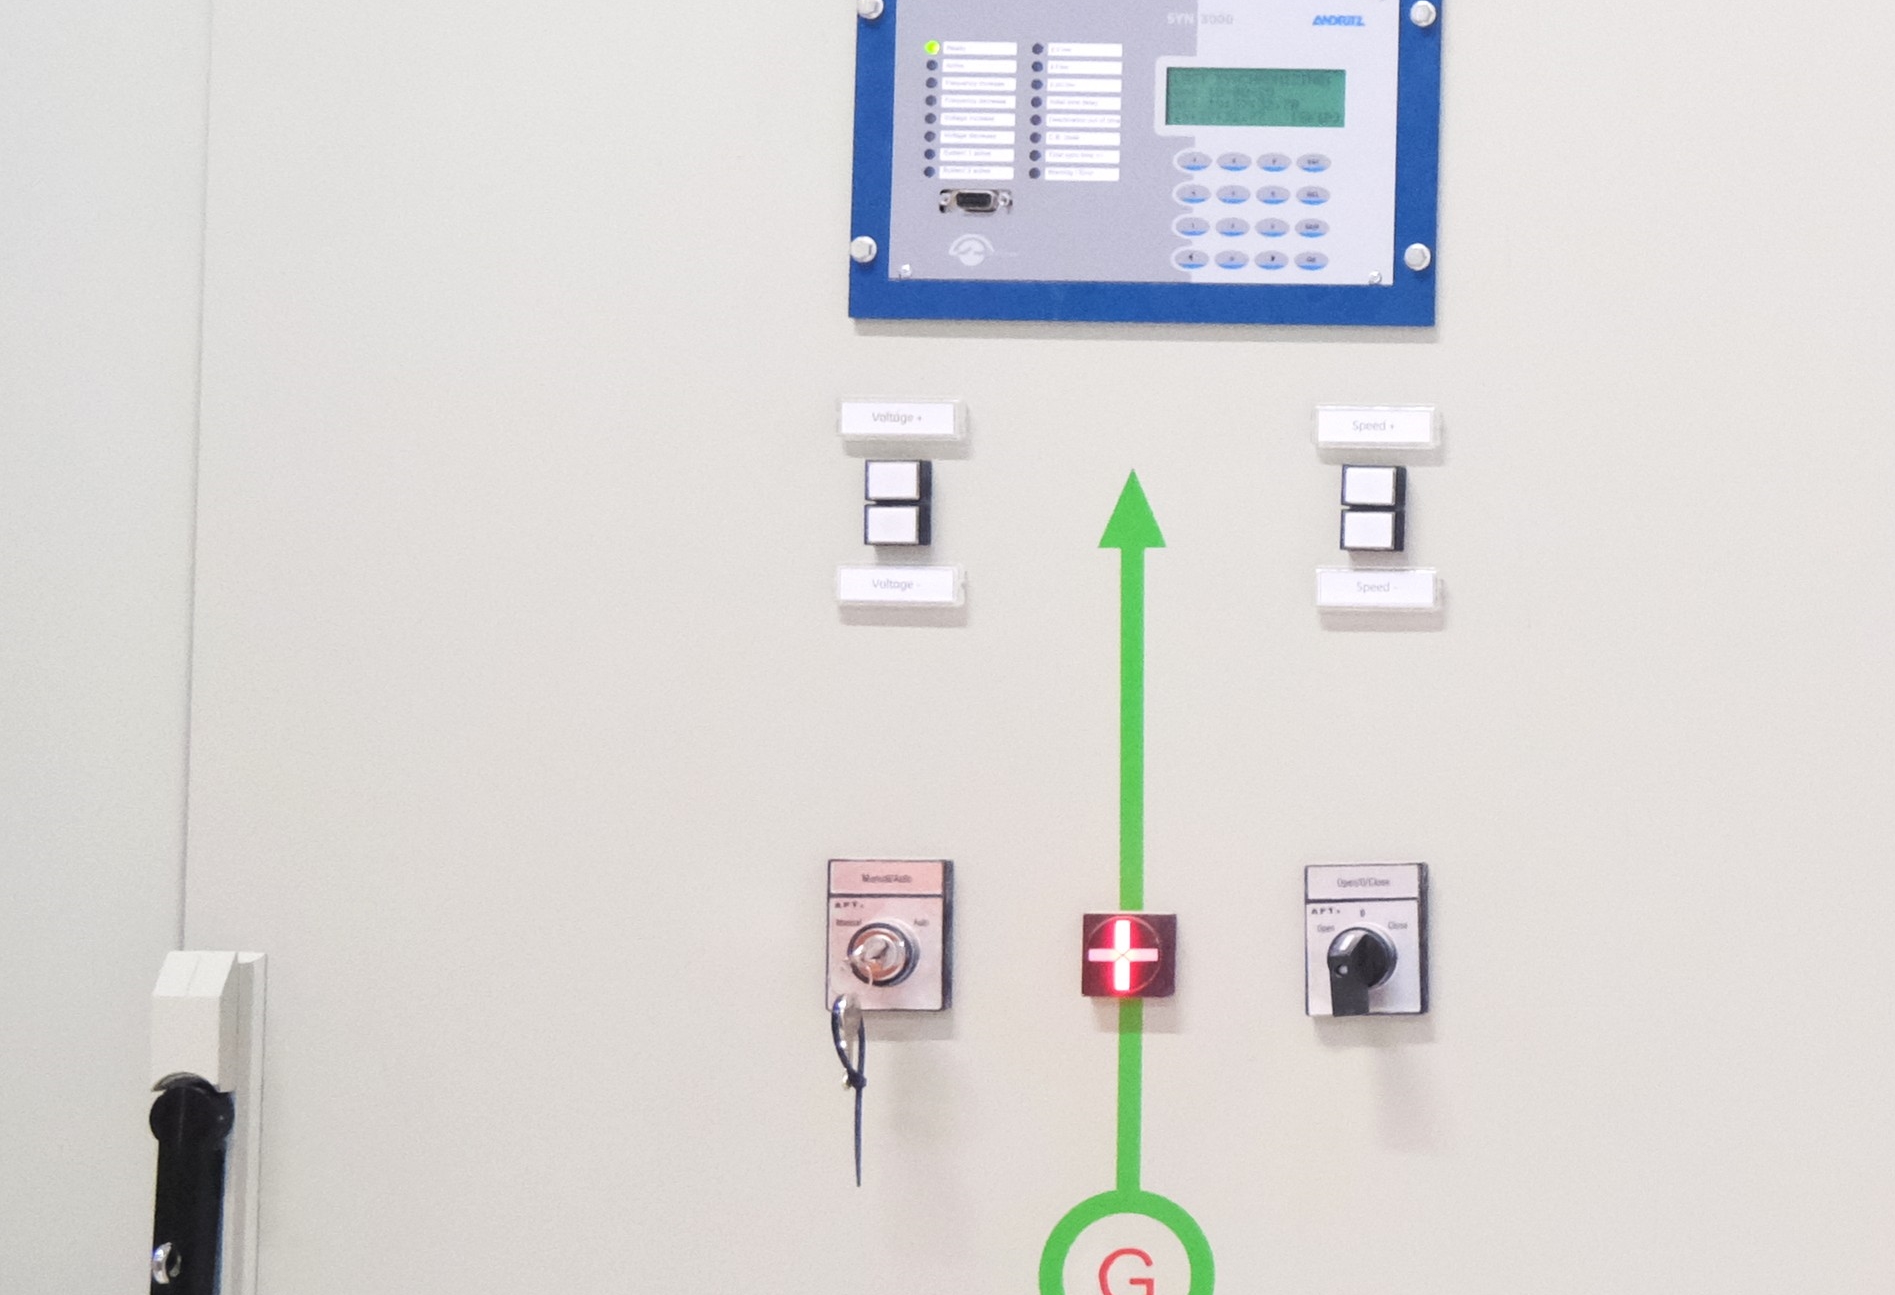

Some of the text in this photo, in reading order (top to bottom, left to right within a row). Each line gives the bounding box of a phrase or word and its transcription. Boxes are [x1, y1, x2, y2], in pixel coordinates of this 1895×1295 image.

[1312, 15, 1365, 26] ANDRITZ
[872, 412, 914, 426] Voltage
[1352, 419, 1386, 433] Speed
[872, 578, 914, 592] Voltage
[1356, 580, 1390, 594] Speed
